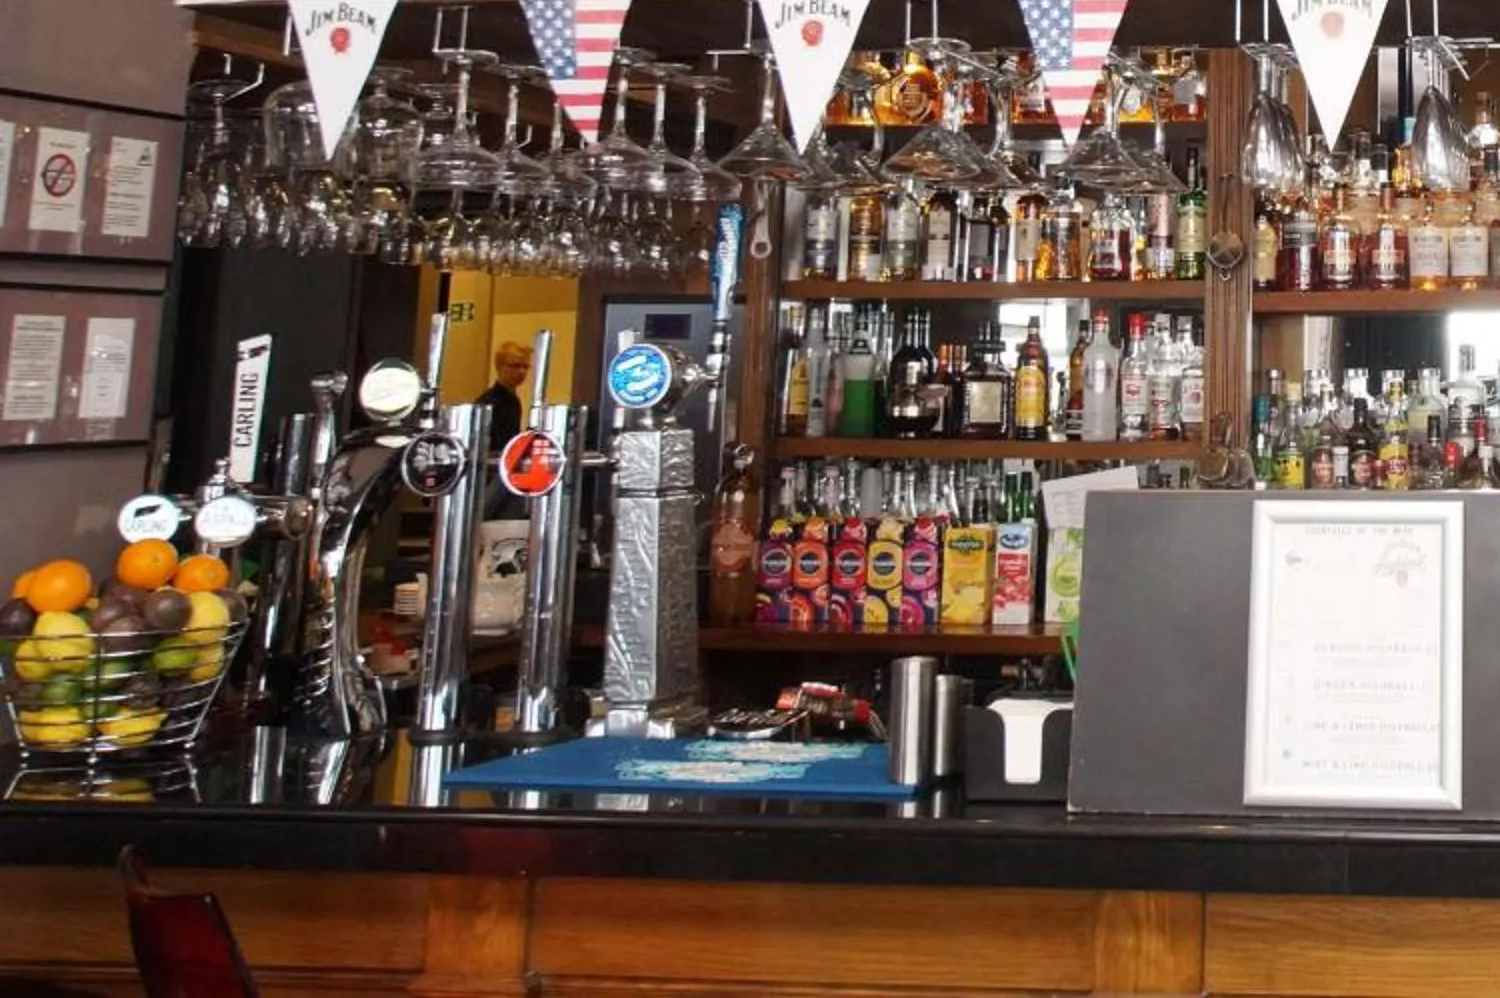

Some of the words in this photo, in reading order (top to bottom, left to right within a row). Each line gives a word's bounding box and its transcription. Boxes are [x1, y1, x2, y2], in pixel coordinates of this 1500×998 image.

[305, 9, 334, 36] JIM
[337, 2, 376, 34] BEAM
[775, 0, 805, 29] JIM
[234, 372, 259, 447] CARLING
